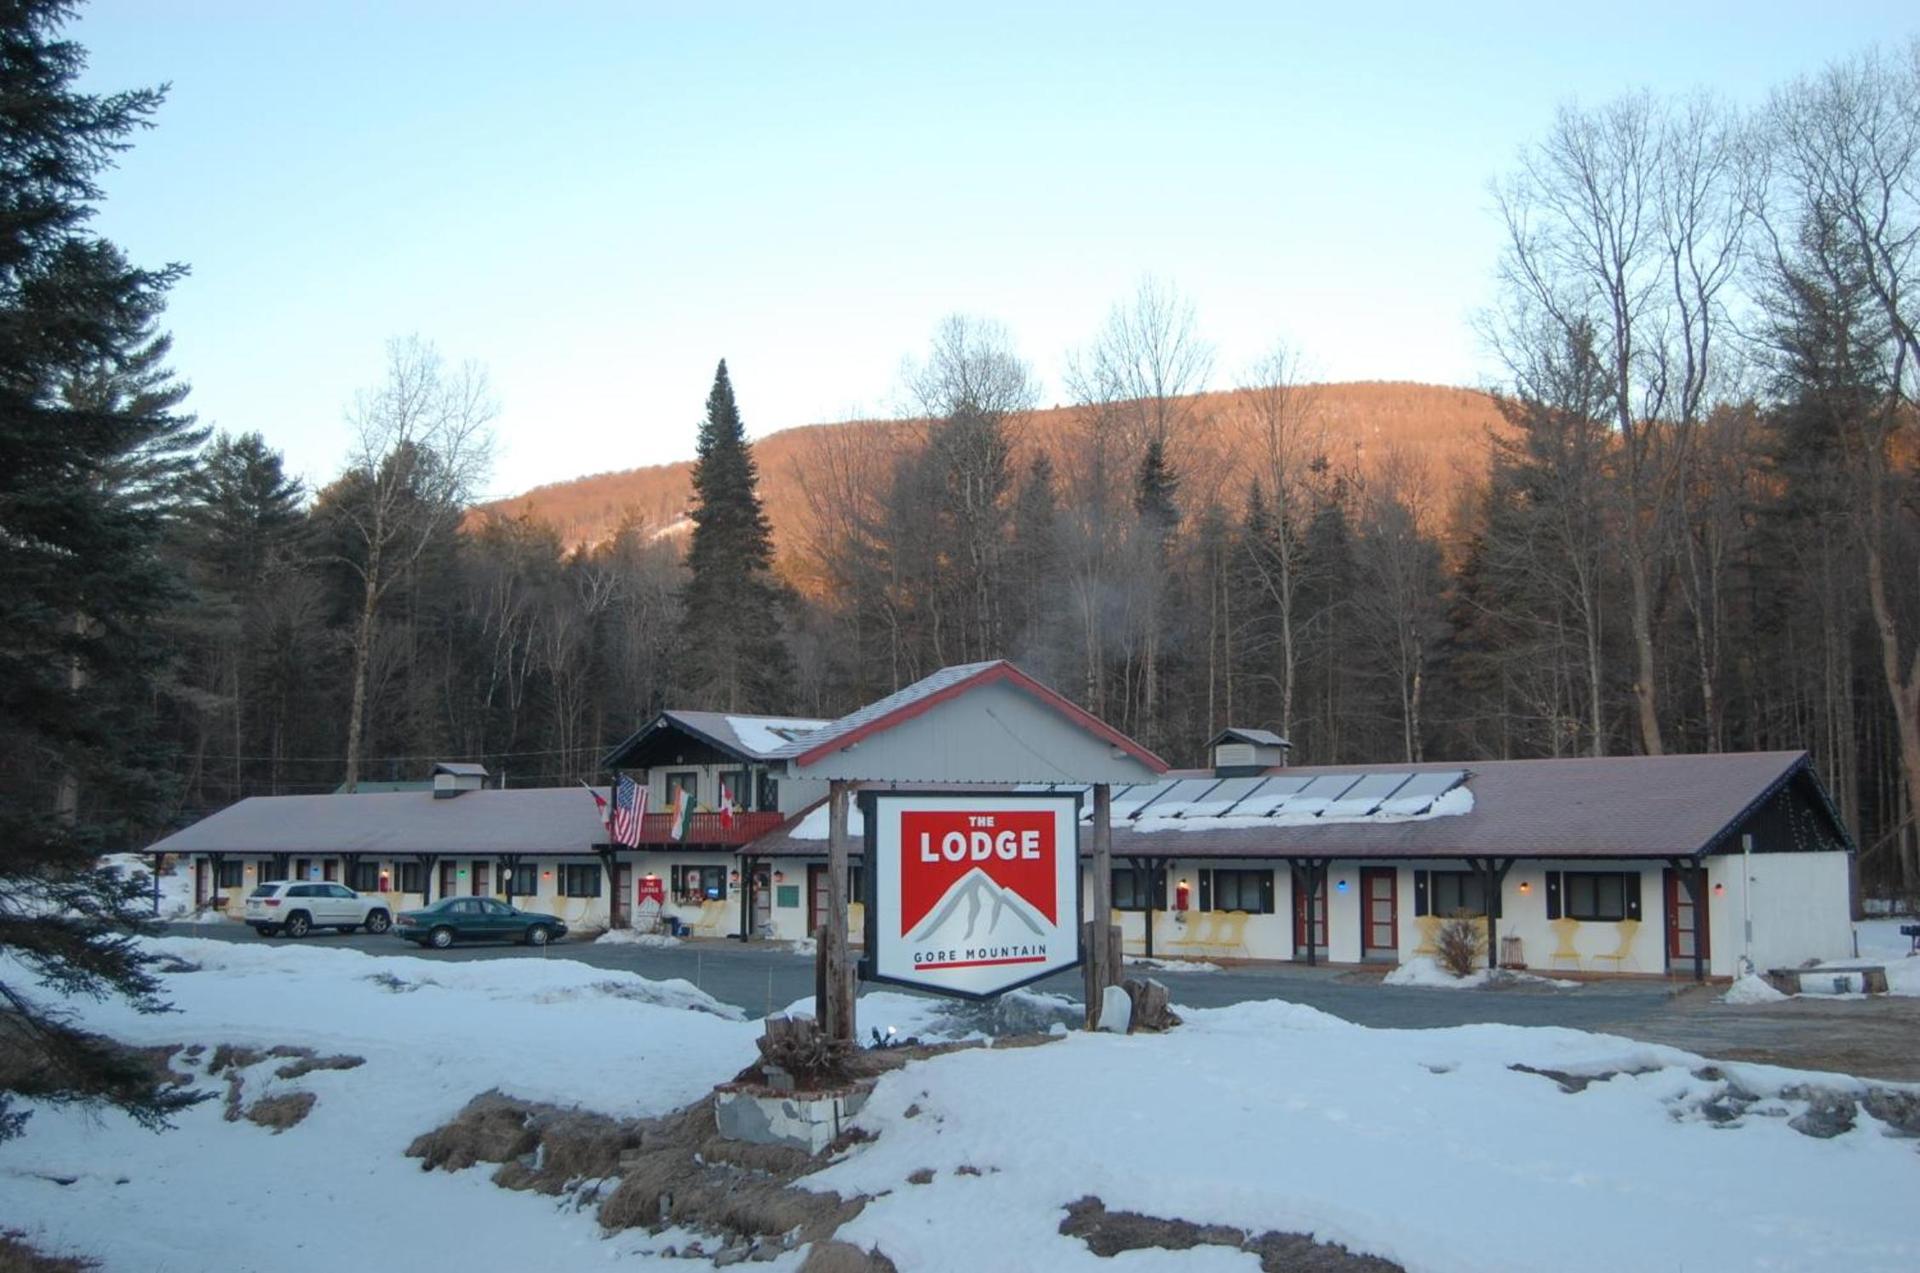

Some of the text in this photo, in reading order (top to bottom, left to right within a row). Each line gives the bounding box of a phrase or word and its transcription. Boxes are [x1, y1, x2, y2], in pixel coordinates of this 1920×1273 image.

[968, 816, 995, 827] THE
[921, 830, 1041, 862] LODGE
[914, 944, 1046, 963] GORE MOUNTAIN
